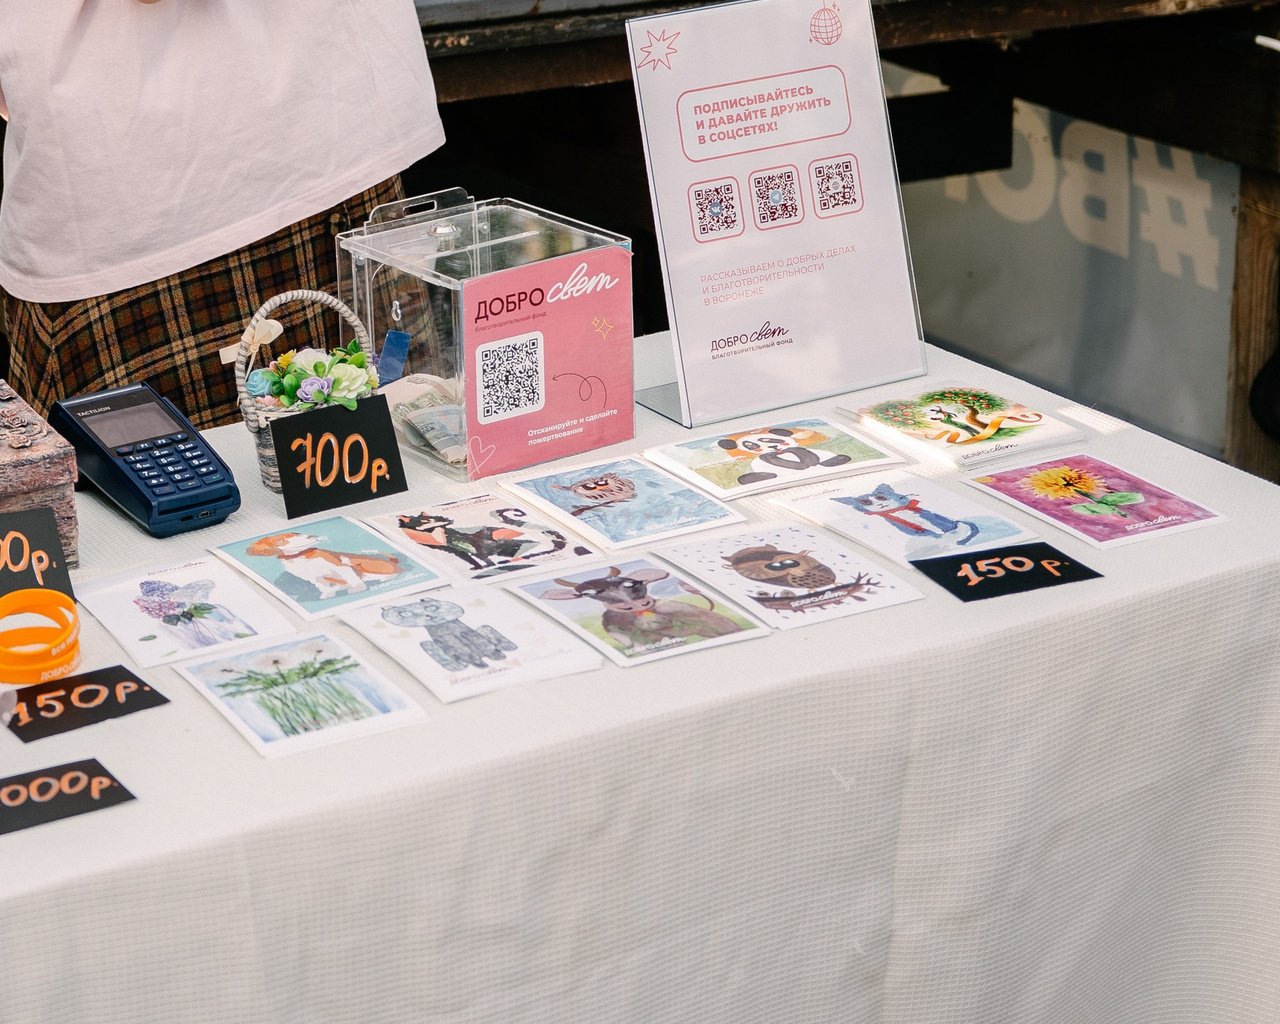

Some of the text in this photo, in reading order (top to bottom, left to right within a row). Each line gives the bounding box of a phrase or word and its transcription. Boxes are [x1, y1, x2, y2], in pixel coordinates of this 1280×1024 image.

[693, 85, 814, 116] ПОДПИСЫВАЙТЕСЬ
[695, 97, 832, 130] И ДАВАЙТЕ ДРУЖИТЬ
[698, 121, 779, 145] В СОЦСЕТЯХ!
[700, 244, 857, 284] РАССКАЗЫВАЕМ О ДОБРЫХ ДЕЛАХ
[702, 262, 825, 295] И БЛАГОТВОРИТЕЛЬНОСТИ
[704, 286, 765, 307] В ВОРОНЕЖЕ
[474, 311, 547, 333] благотворительный фонд
[711, 338, 794, 360] БЛАГОТВОРИТЕЛЬНЫЙ ФОНД
[527, 419, 578, 437] Отсканируйте
[585, 408, 618, 423] сделайте
[527, 426, 584, 446] пожертвование
